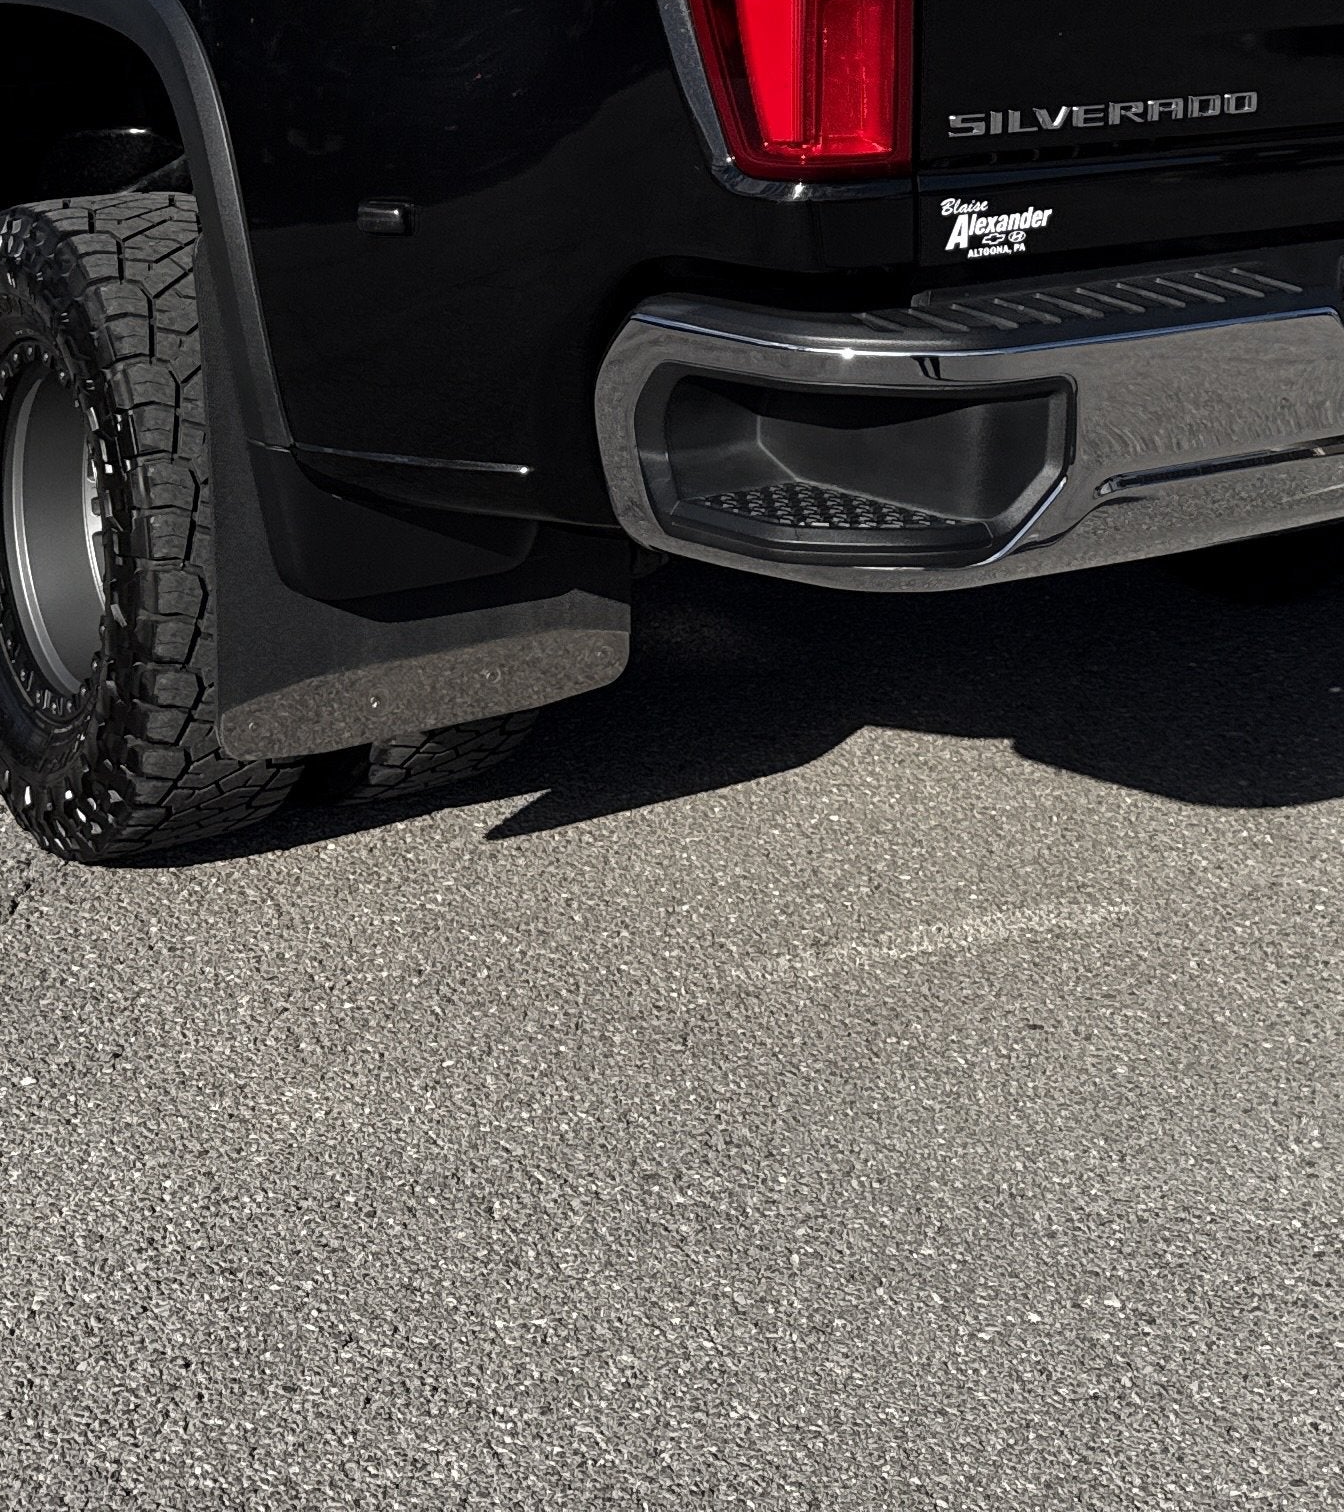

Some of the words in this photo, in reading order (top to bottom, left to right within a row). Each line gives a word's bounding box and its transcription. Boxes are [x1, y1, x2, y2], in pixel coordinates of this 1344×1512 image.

[948, 91, 1257, 137] SILVERADO
[940, 197, 989, 216] Blaise
[945, 206, 1053, 250] Alexander
[967, 245, 1013, 259] ALTOONA,
[1013, 242, 1026, 253] PA
